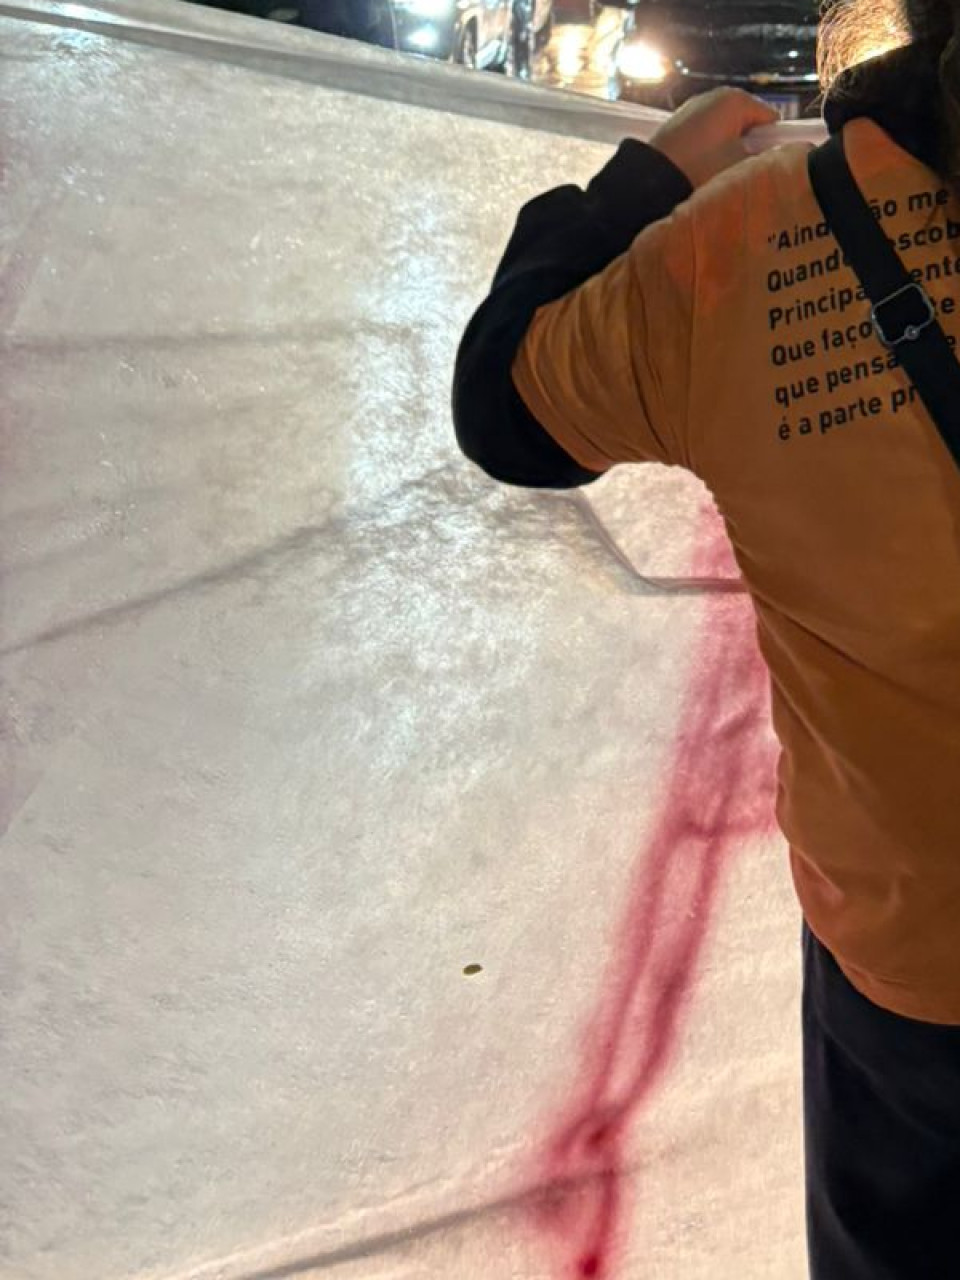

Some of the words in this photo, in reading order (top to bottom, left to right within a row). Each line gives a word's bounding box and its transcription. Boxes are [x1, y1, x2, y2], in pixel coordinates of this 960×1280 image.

[868, 198, 897, 220] ão
[908, 189, 948, 212] me
[767, 248, 848, 293] Quand
[771, 340, 816, 367] Que
[822, 321, 874, 351] faço
[774, 376, 819, 408] que
[826, 352, 899, 393] pensa
[778, 415, 791, 440] é
[799, 417, 812, 436] a
[819, 396, 883, 434] parte
